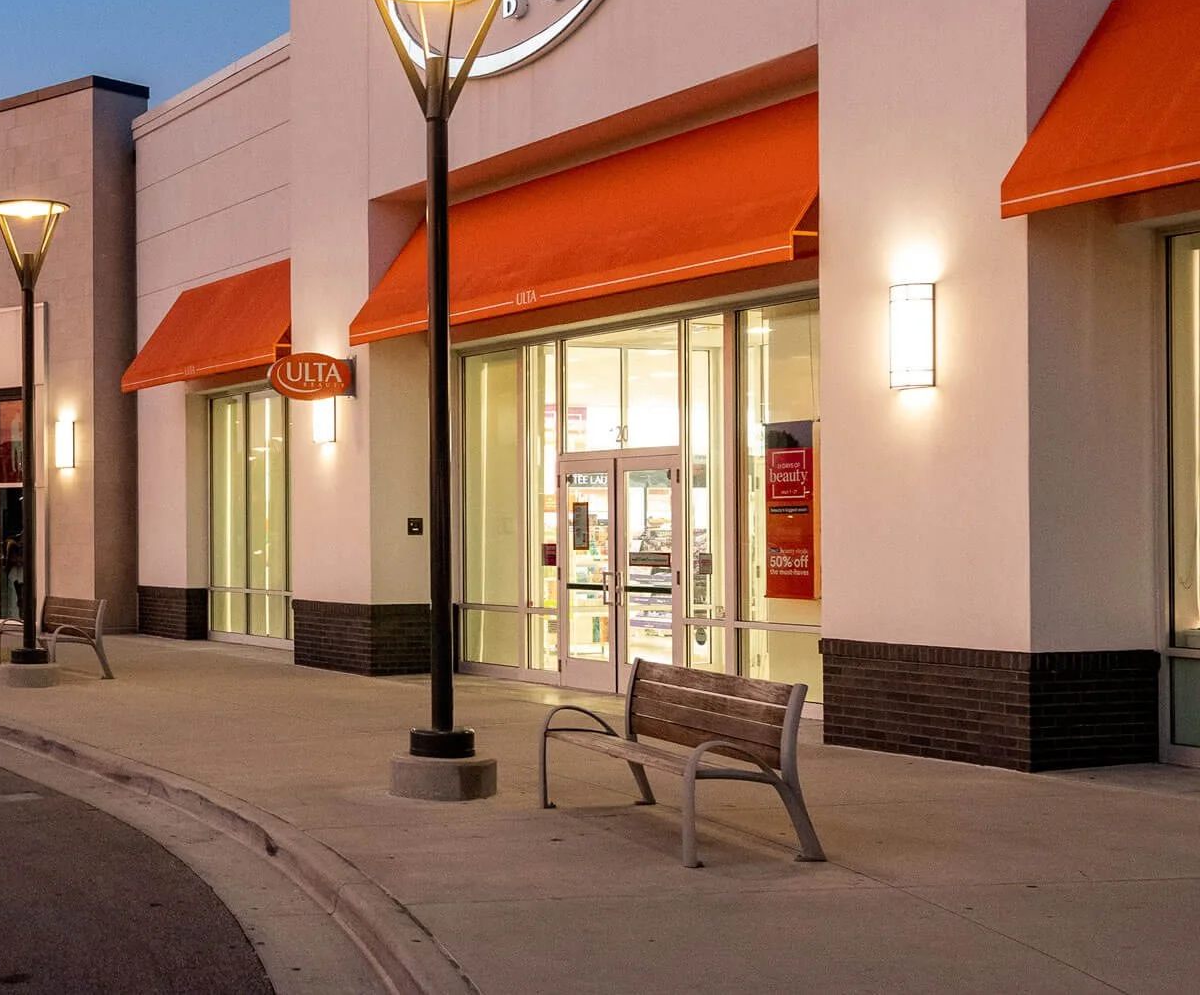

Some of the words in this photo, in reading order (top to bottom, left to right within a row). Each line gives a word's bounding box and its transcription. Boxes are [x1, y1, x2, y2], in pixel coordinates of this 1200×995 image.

[516, 289, 537, 306] ULTA
[286, 362, 342, 383] ULTA
[769, 468, 809, 485] beauty
[770, 555, 793, 568] 50%
[793, 555, 809, 568] off
